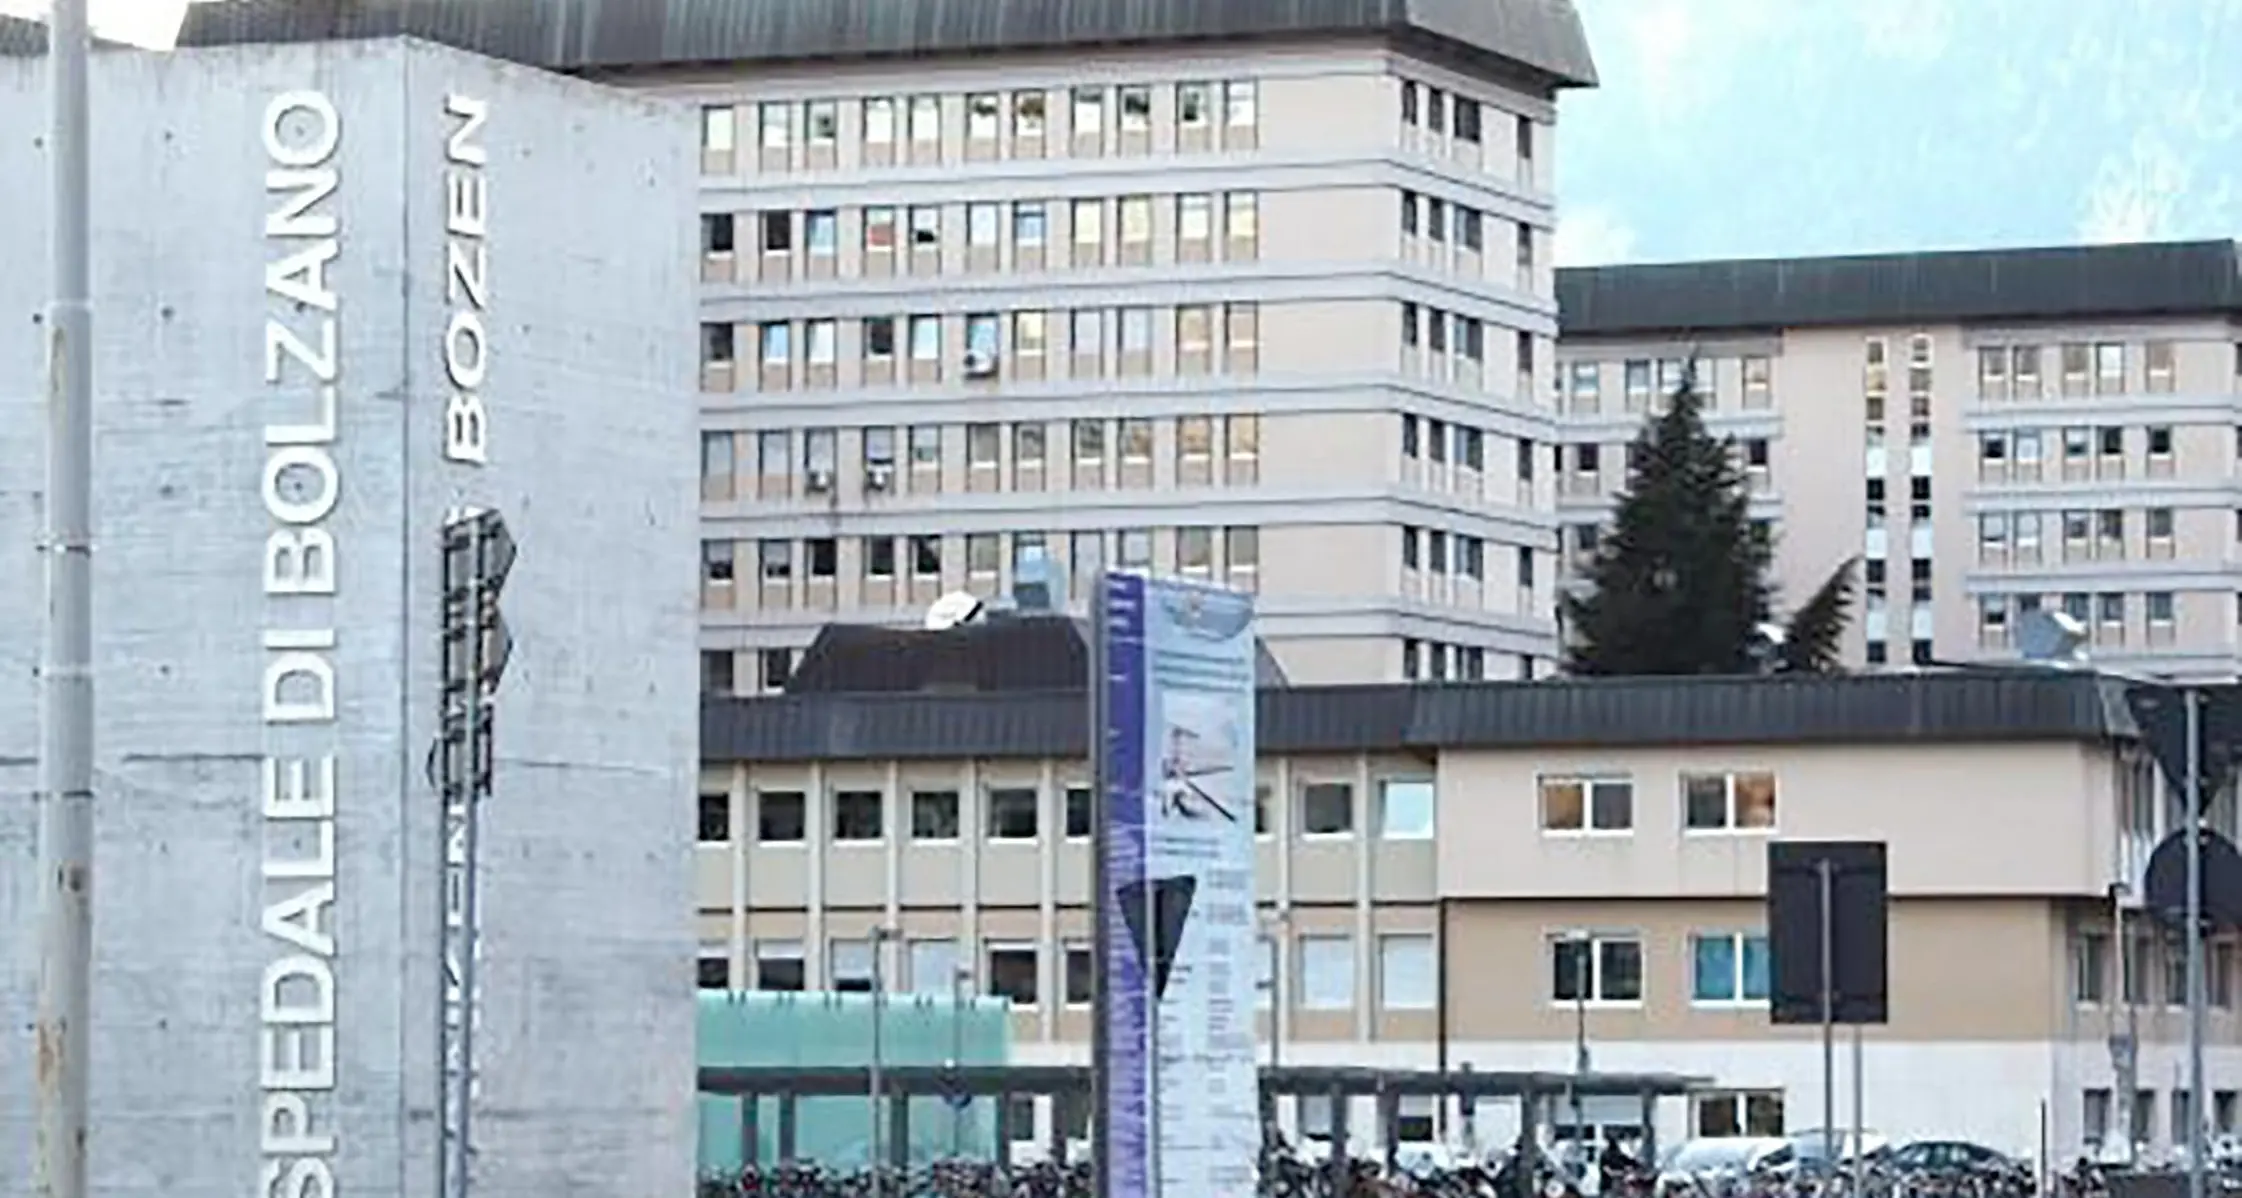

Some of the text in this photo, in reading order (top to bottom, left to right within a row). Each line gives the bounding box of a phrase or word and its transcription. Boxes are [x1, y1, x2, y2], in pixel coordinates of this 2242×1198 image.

[261, 90, 339, 595] BOLZANO
[445, 93, 488, 463] BOZEN
[262, 628, 336, 724] DI
